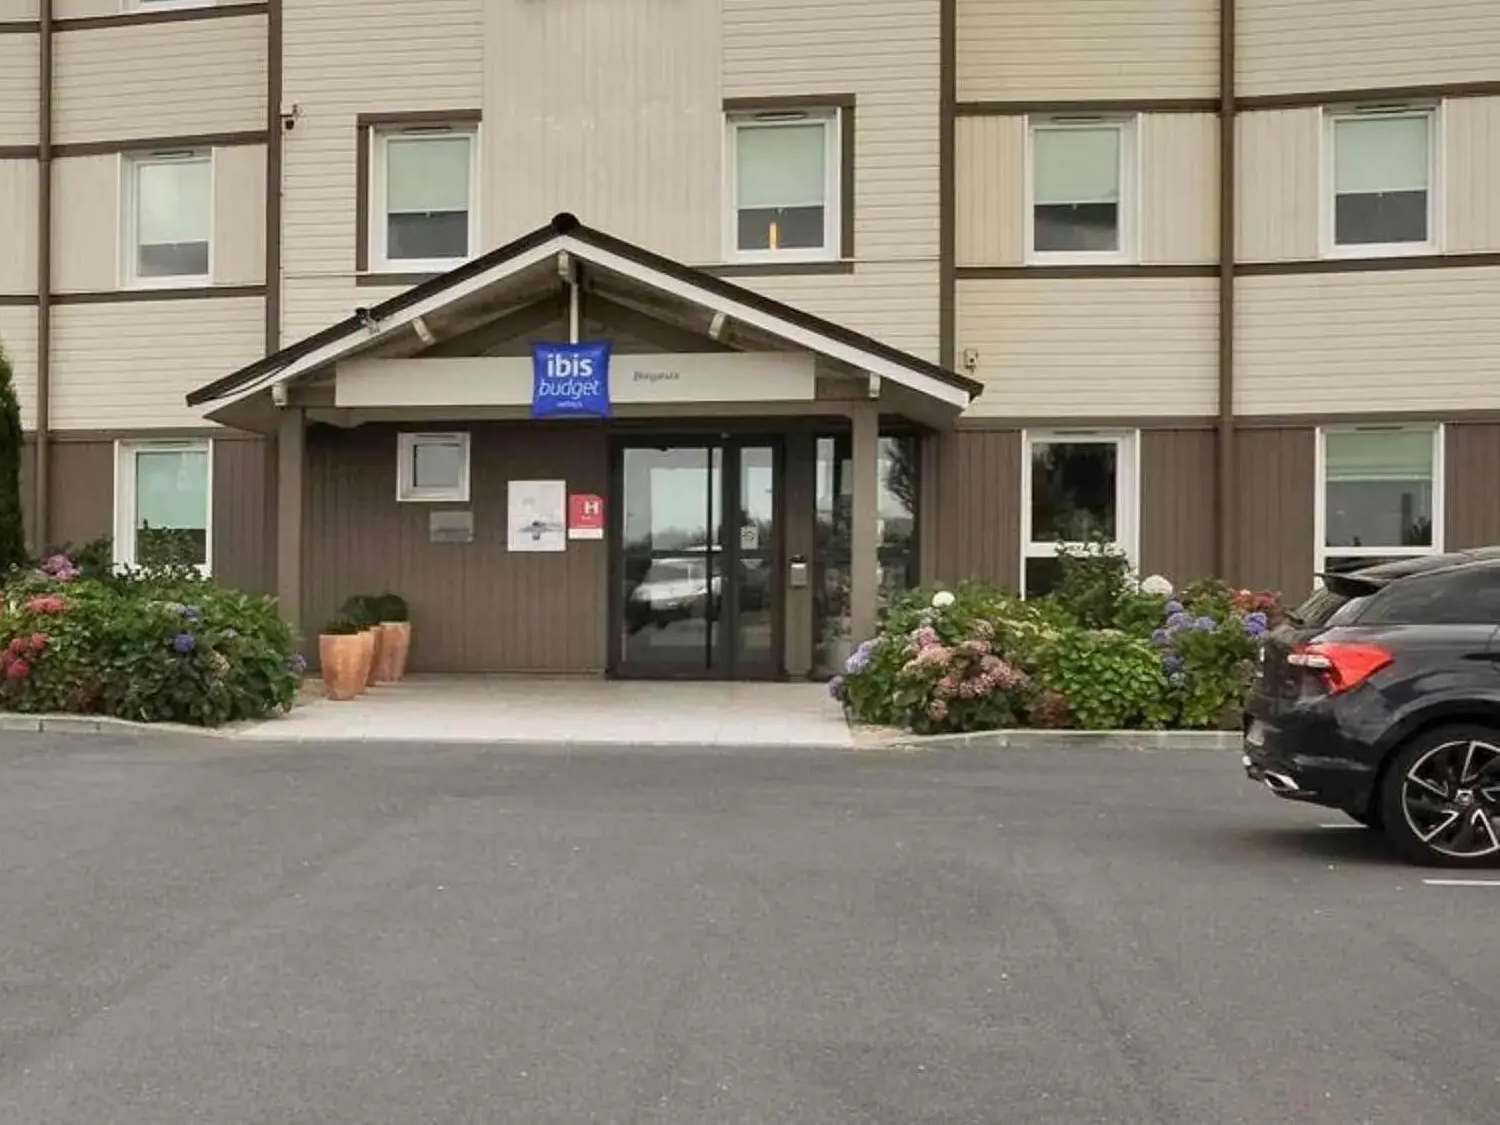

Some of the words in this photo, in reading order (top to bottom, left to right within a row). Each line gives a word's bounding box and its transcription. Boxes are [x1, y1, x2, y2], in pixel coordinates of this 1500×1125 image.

[547, 353, 593, 377] ibis
[539, 378, 600, 400] budget
[584, 500, 599, 515] H
